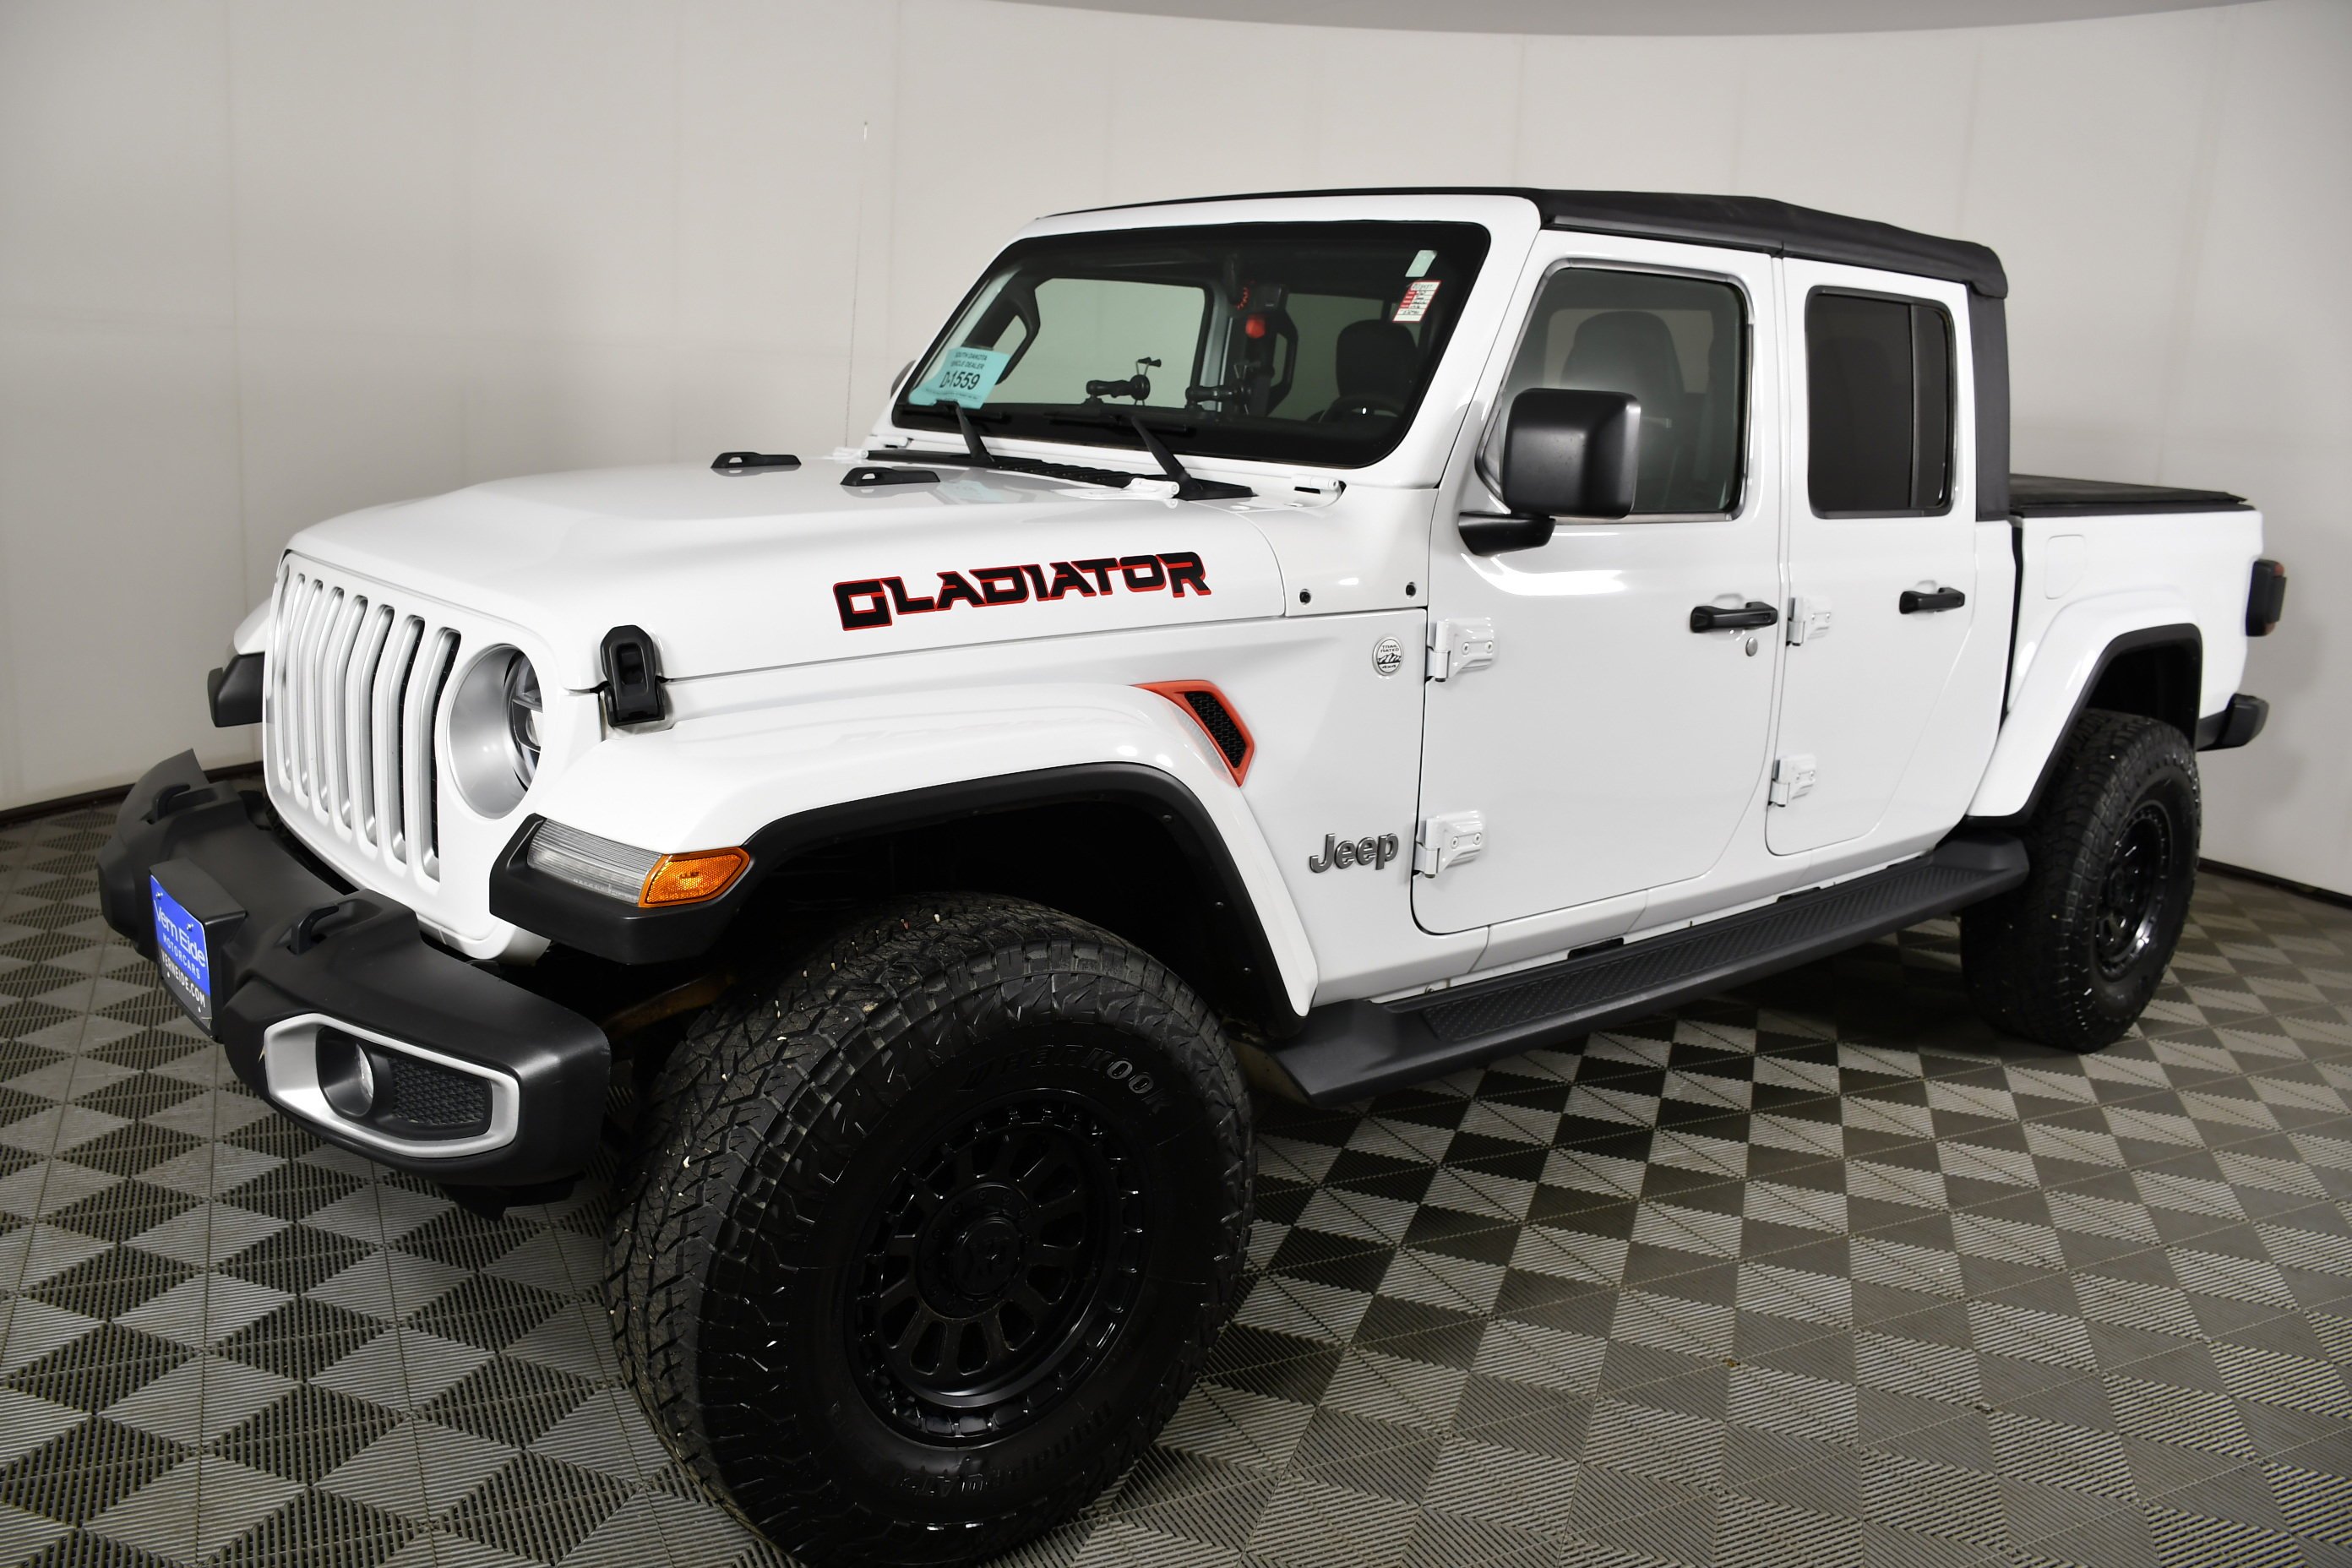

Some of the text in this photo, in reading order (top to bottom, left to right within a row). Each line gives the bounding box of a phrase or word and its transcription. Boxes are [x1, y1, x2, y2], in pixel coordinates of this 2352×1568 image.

[939, 371, 980, 390] D-1559
[832, 551, 1211, 631] GLADIATOR
[1309, 833, 1399, 874] Jeep
[154, 899, 206, 967] Vern Eide
[162, 933, 201, 980] MOTORCARS
[161, 949, 206, 1008] VERNEIDE.COM
